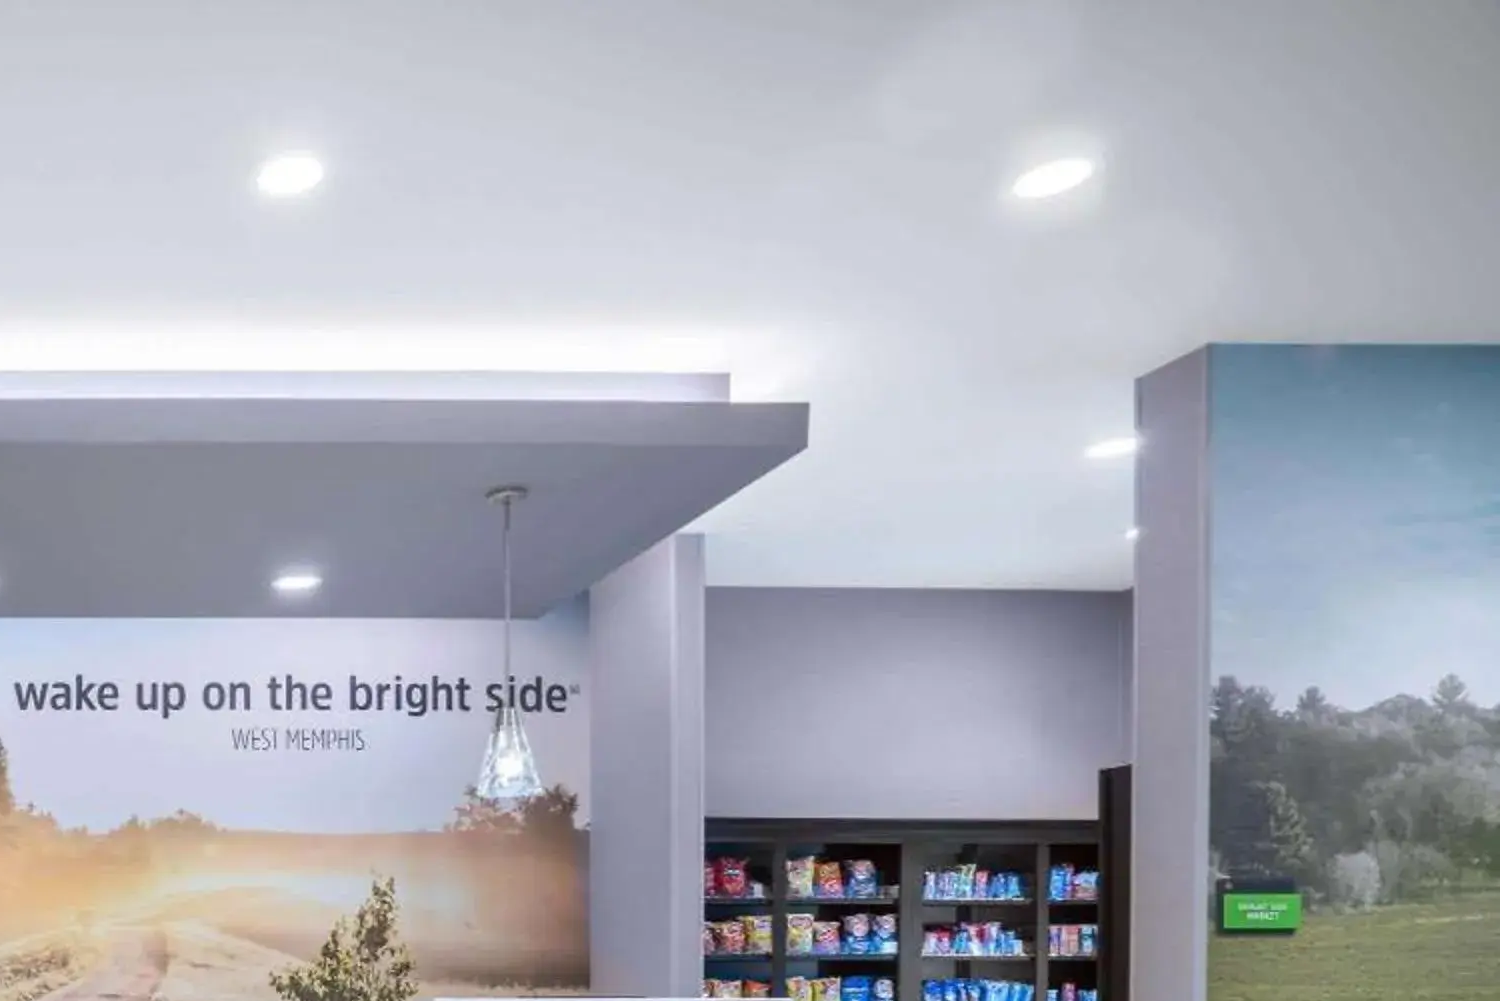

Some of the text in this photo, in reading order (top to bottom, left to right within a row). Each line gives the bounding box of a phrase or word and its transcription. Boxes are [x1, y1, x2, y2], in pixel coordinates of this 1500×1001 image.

[13, 673, 120, 712] wake
[135, 681, 187, 720] up
[202, 681, 251, 712] on
[267, 673, 333, 712] the
[349, 674, 473, 718] bright
[231, 727, 366, 752] WEST MEMPHIS
